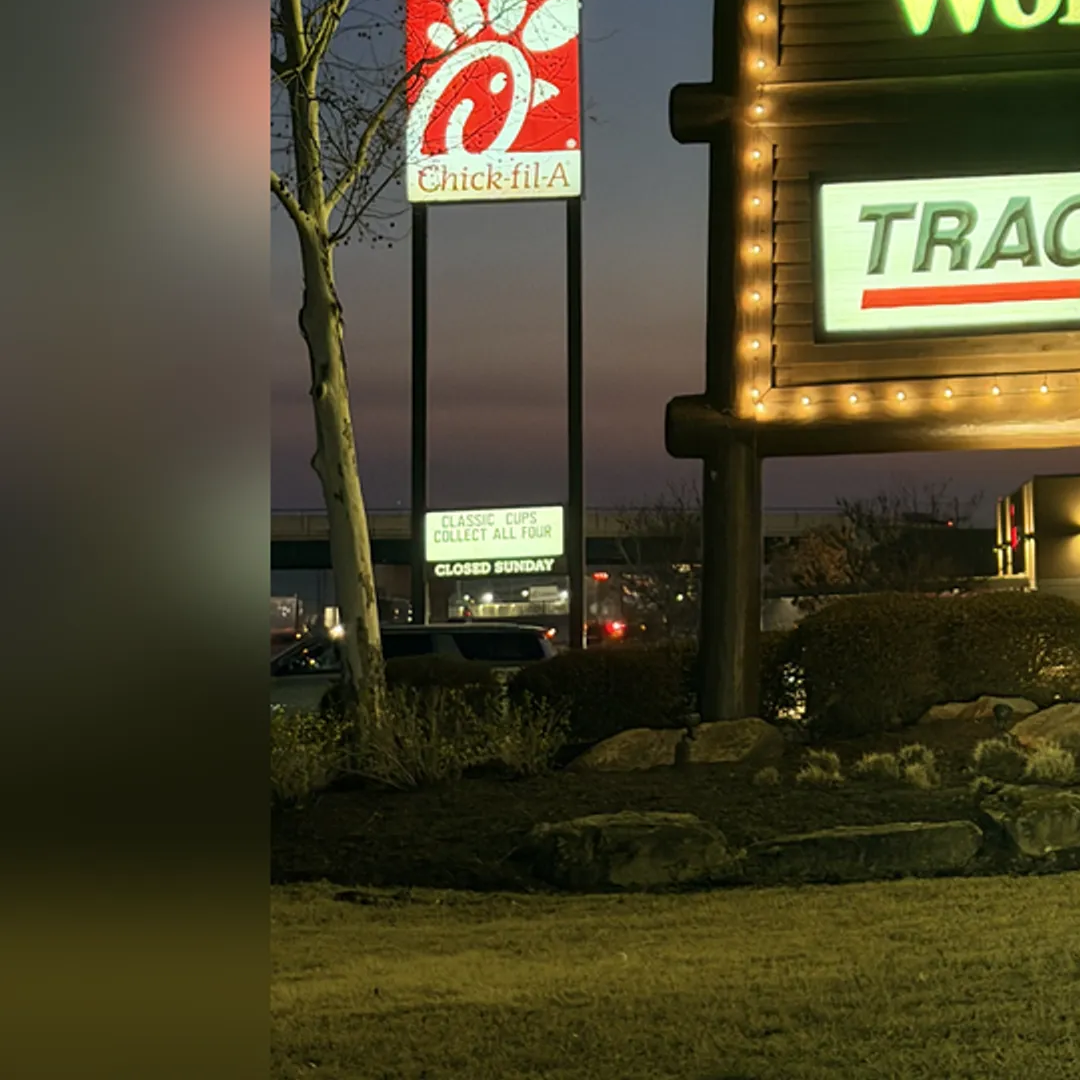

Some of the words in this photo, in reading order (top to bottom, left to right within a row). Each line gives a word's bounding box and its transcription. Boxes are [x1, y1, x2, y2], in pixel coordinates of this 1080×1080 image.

[418, 160, 570, 193] Chick-fil-A
[441, 513, 495, 529] CLASSIC
[505, 511, 537, 526] CUPS
[434, 528, 487, 543] COLLECT
[493, 526, 517, 541] ALL
[521, 524, 552, 539] FOUR
[434, 561, 491, 577] CLOSED
[494, 558, 555, 575] SUNDAY
